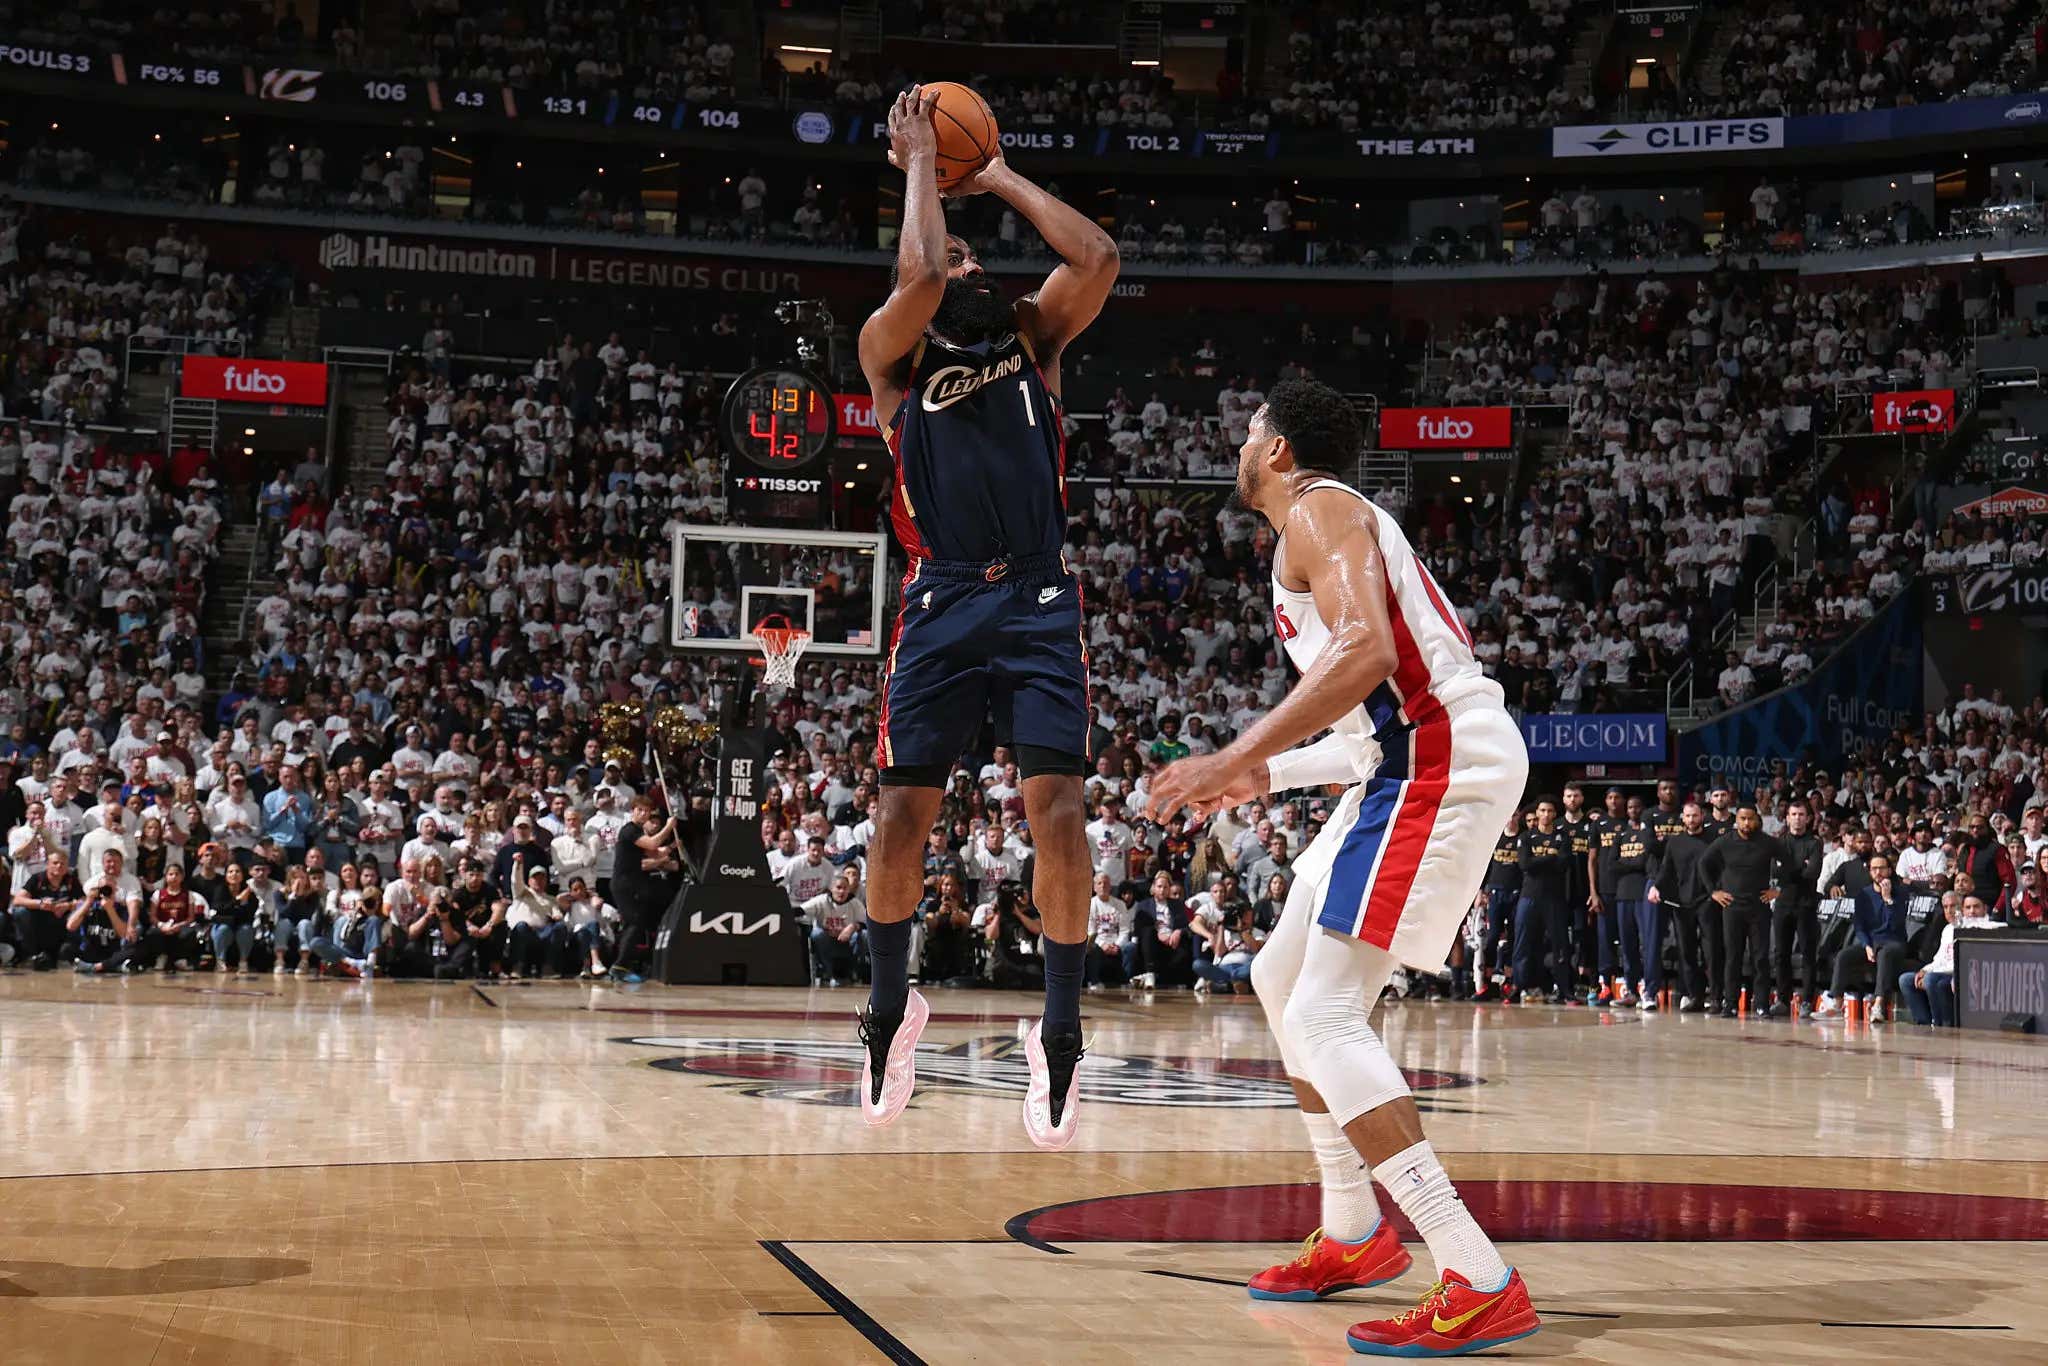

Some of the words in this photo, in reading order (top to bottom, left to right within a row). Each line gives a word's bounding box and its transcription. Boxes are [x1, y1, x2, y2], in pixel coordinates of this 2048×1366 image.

[73, 54, 91, 72] 3
[140, 64, 186, 83] FG%
[193, 68, 221, 85] 56
[364, 80, 407, 101] 106
[454, 91, 484, 107] 4.3
[543, 97, 587, 115] 1:31
[632, 105, 661, 123] 4Q
[699, 109, 740, 128] 104
[1061, 135, 1076, 149] 3
[1126, 135, 1162, 151] TOL
[1167, 136, 1181, 151] 2
[1645, 122, 1770, 149] CLIFFS
[1356, 138, 1414, 156] THE
[1417, 138, 1475, 155] 4TH
[570, 257, 710, 290] LEGENDS
[223, 365, 287, 394] fubo
[771, 387, 815, 414] 1:31
[1018, 380, 1036, 427] 1
[750, 412, 799, 459] 4.2
[1417, 415, 1474, 439] fubo
[758, 477, 822, 493] TISSOT
[1980, 497, 2047, 515] SERVPRO
[1041, 586, 1059, 597] NIKE
[1935, 593, 1946, 612] 3
[1826, 693, 1859, 722] Full
[731, 758, 753, 777] GET
[1695, 753, 1798, 775] COMCAST
[731, 778, 752, 796] THE
[735, 800, 757, 821] App
[719, 864, 756, 879] Google
[690, 910, 781, 936] KIA
[1980, 959, 2045, 1015] PLAYOFFS
